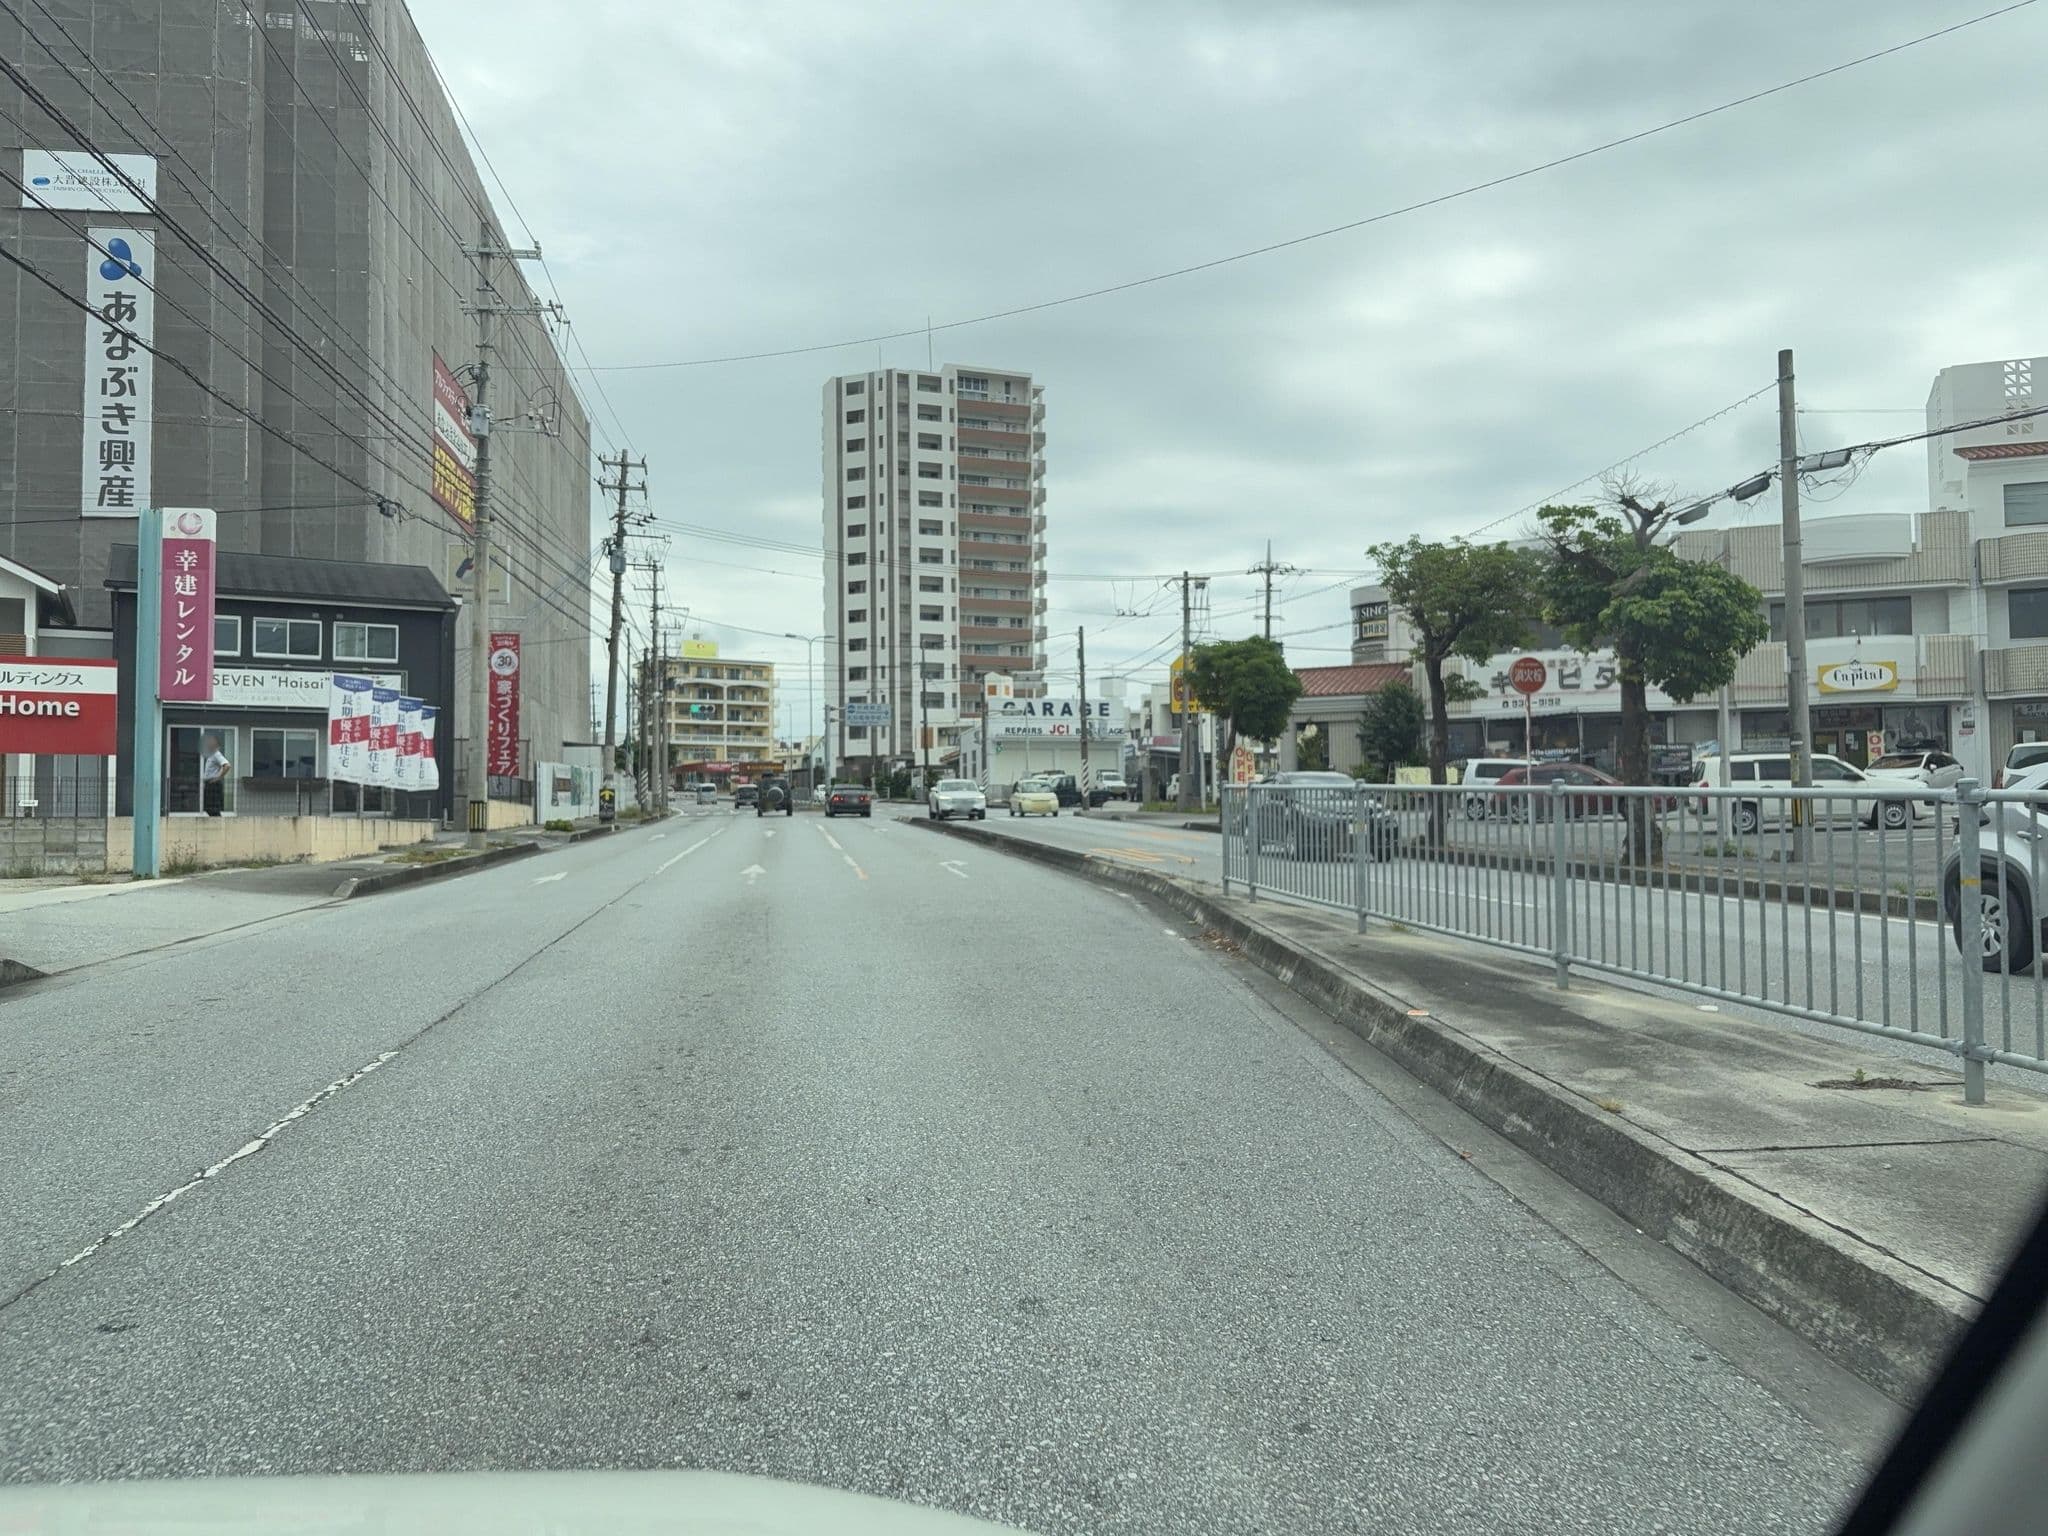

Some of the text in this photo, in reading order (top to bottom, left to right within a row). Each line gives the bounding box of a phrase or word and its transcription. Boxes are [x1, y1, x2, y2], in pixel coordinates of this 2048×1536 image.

[98, 291, 138, 507] あなぶき興産
[173, 550, 198, 686] 幸建レンタル
[213, 674, 265, 687] SEVEN
[1834, 668, 1882, 686] Capital
[0, 694, 80, 716] Home
[496, 680, 513, 774] 家づくりフェア
[341, 694, 353, 768] 長期優良住宅
[1050, 724, 1070, 735] JCI
